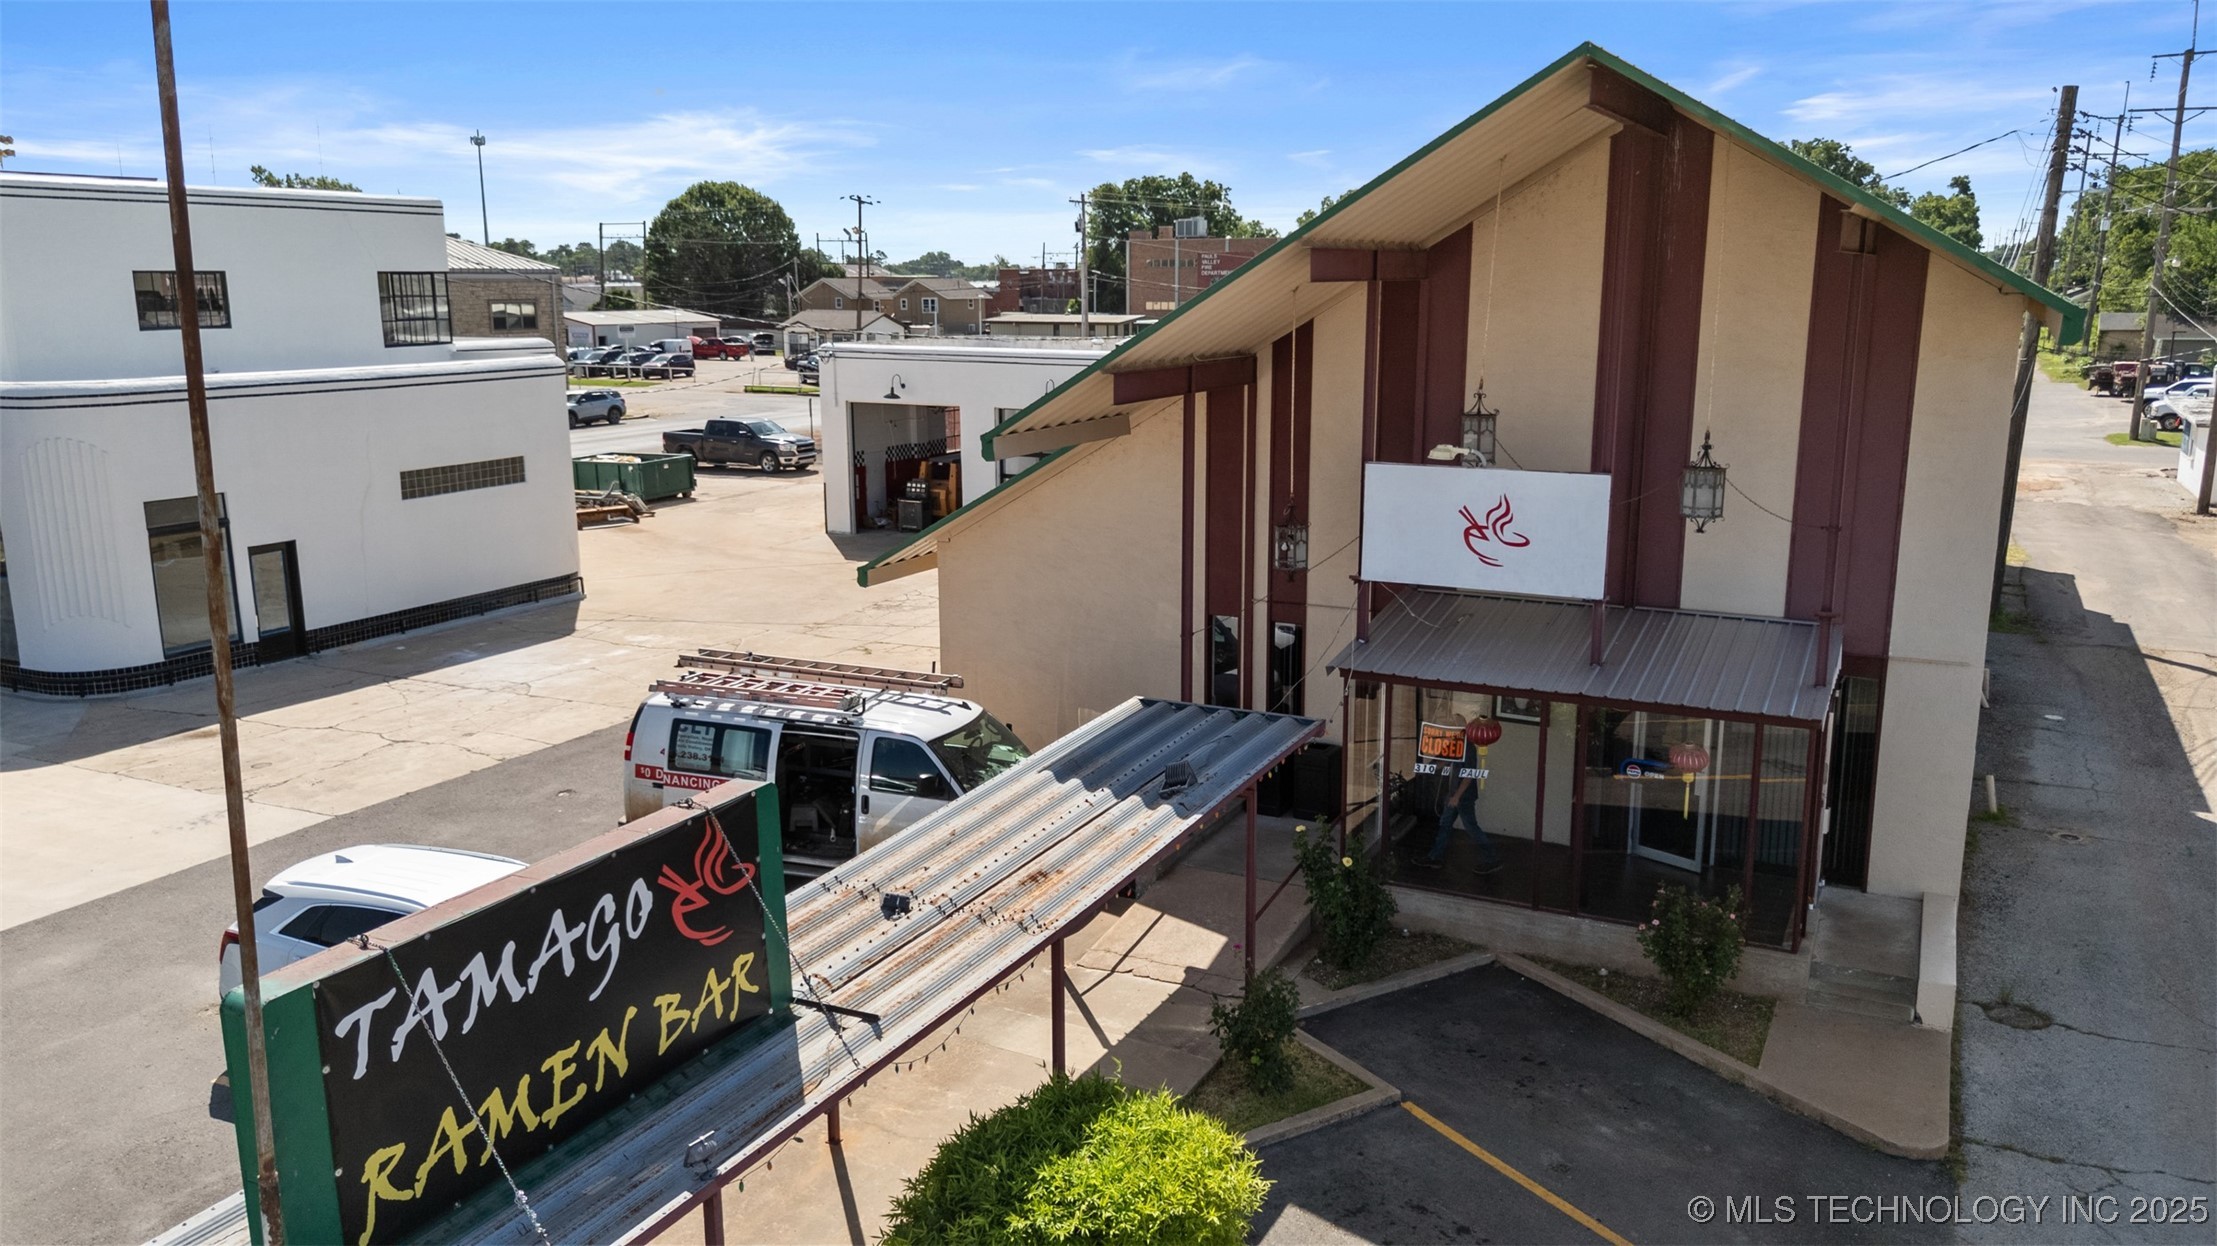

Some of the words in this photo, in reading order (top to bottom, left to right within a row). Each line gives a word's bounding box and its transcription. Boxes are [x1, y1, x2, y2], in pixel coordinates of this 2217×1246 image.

[1421, 735, 1465, 758] CLOSED
[1415, 765, 1435, 773] 310
[1460, 770, 1486, 778] PAUL
[1644, 771, 1664, 780] OPEN
[334, 877, 654, 1080] TAMAGO
[358, 1006, 638, 1246] RAMEN
[653, 951, 760, 1056] BAR
